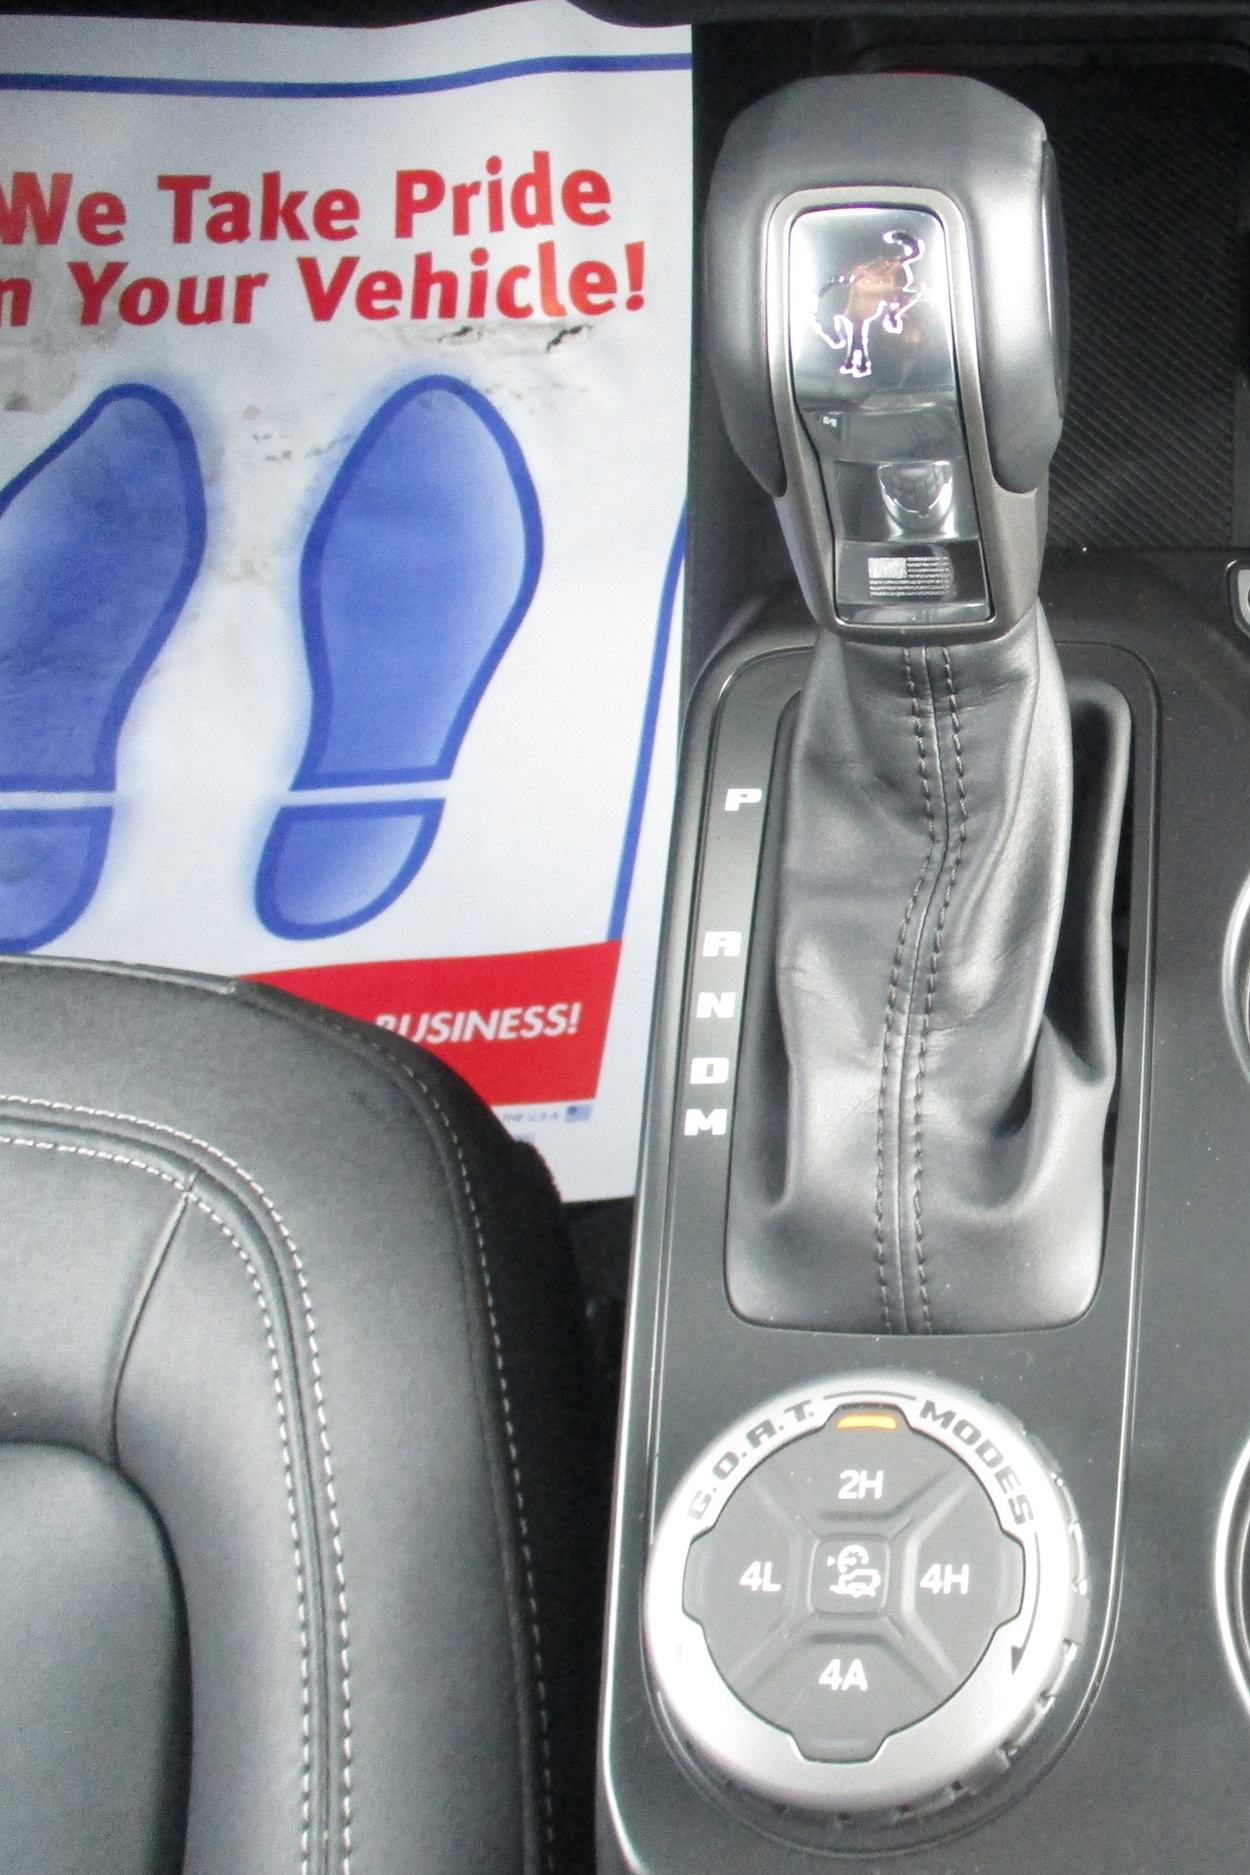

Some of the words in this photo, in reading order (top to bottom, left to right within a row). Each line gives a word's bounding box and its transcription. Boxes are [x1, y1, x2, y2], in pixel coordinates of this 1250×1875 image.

[0, 171, 126, 245] We
[158, 170, 361, 244] Take
[394, 150, 612, 239] Pride
[67, 261, 268, 327] Your
[297, 240, 645, 322] Vehicle!
[724, 788, 762, 811] P
[703, 931, 742, 957] R
[696, 992, 736, 1018] N
[690, 1057, 729, 1084] D
[684, 1108, 727, 1136] M
[686, 1399, 814, 1520] G.O.A.T.
[919, 1400, 1034, 1527] MODES
[838, 1470, 884, 1499] 2H
[739, 1561, 781, 1592] 4L
[920, 1563, 969, 1594] 4H
[819, 1659, 868, 1691] 4A
